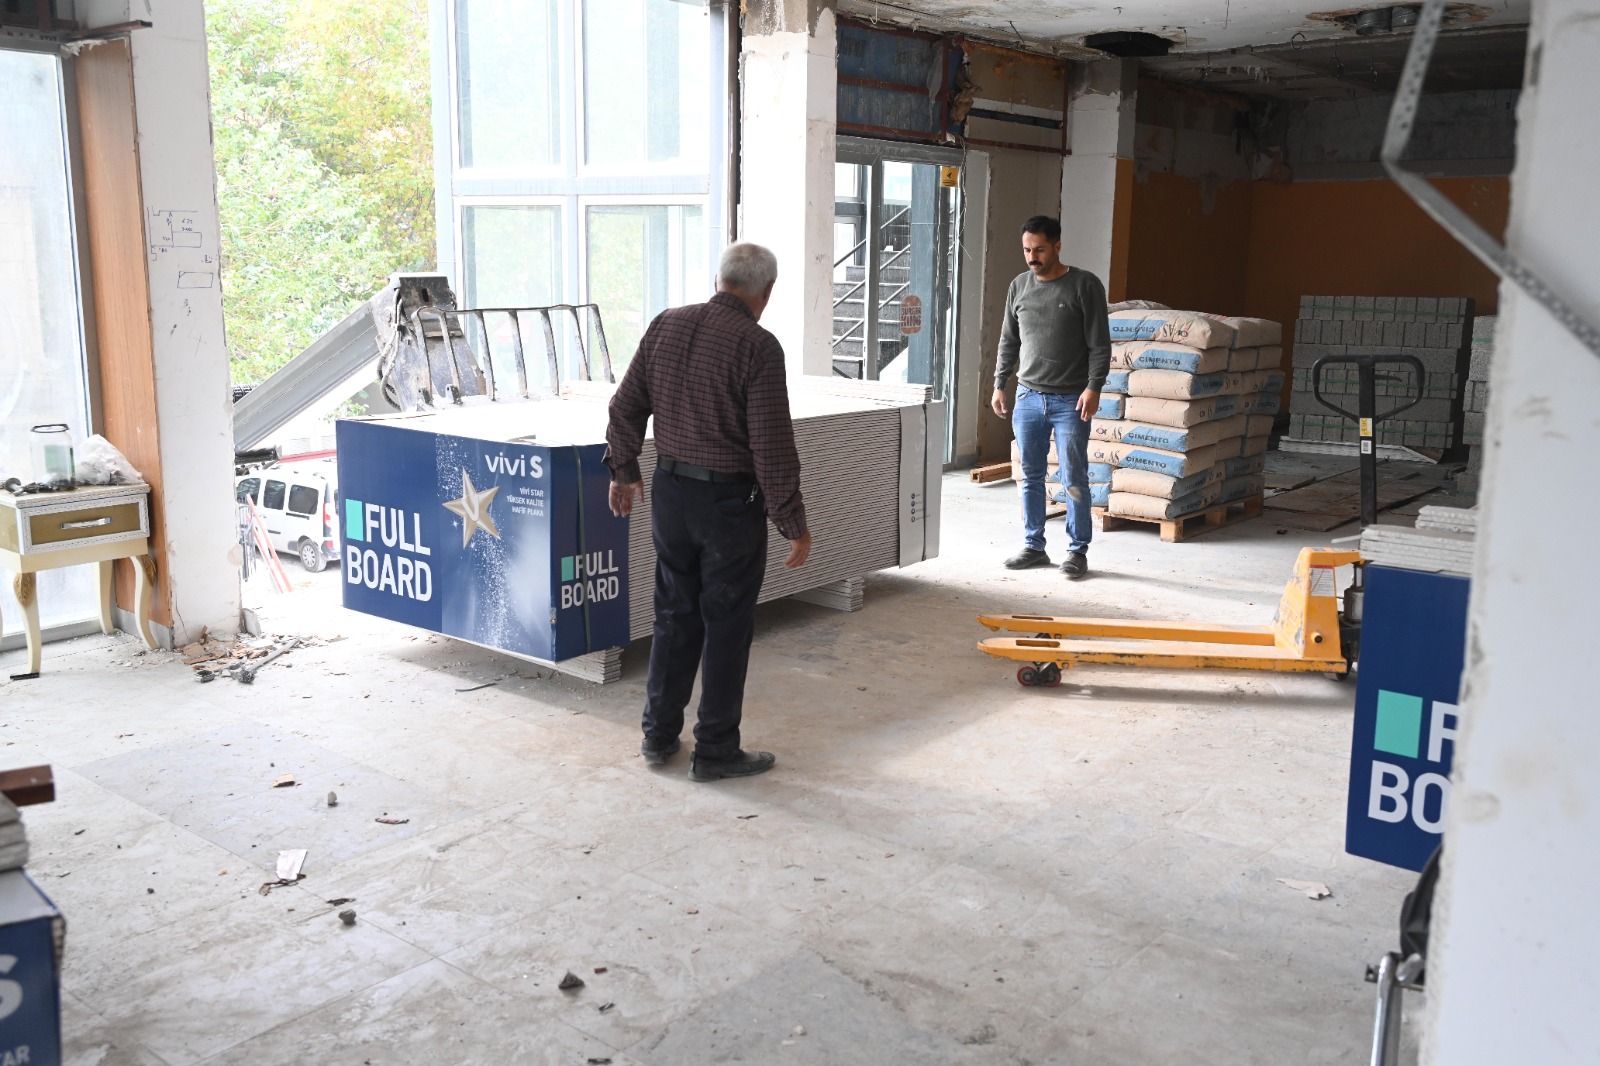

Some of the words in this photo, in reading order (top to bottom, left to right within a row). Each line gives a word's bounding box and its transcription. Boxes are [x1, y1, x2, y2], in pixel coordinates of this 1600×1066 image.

[484, 451, 526, 477] vivi
[529, 455, 544, 479] S
[530, 489, 544, 498] STAR
[365, 502, 431, 556] FULL
[346, 544, 432, 602] BOARD
[575, 549, 619, 579] FULL
[561, 576, 619, 610] BOARD
[1427, 700, 1458, 763] F
[1367, 760, 1451, 834] BO
